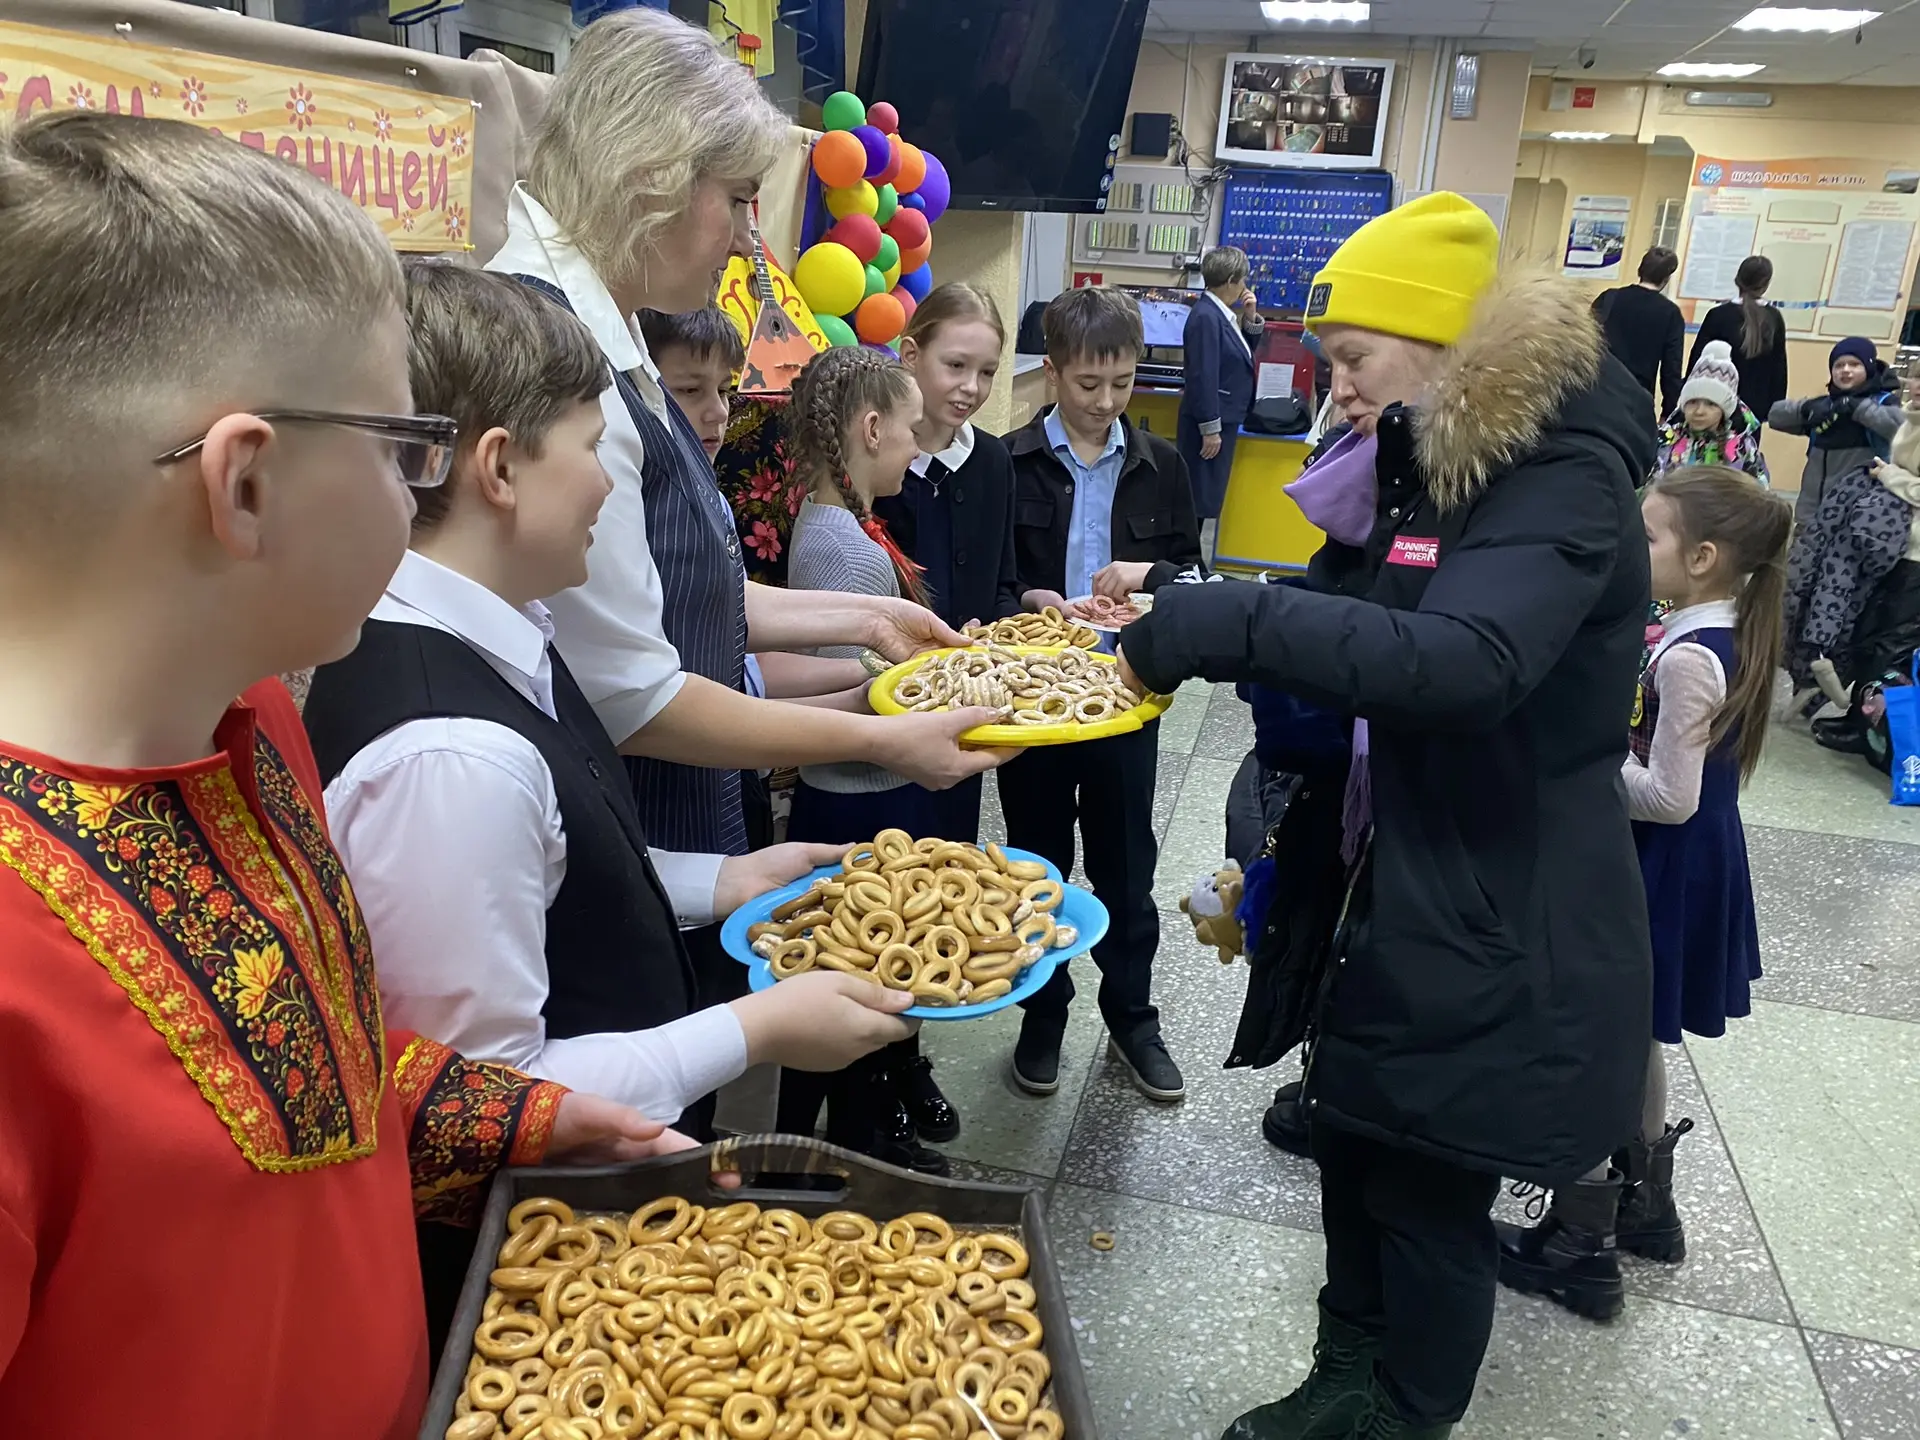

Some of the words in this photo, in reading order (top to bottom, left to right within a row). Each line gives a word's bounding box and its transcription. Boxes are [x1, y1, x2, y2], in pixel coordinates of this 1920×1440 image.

[1731, 171, 1810, 185] ШКОЛЬНАЯ
[1817, 174, 1867, 186] ЖИЗНЬ
[1394, 541, 1430, 552] RUNNING
[1404, 551, 1427, 561] RIVER
